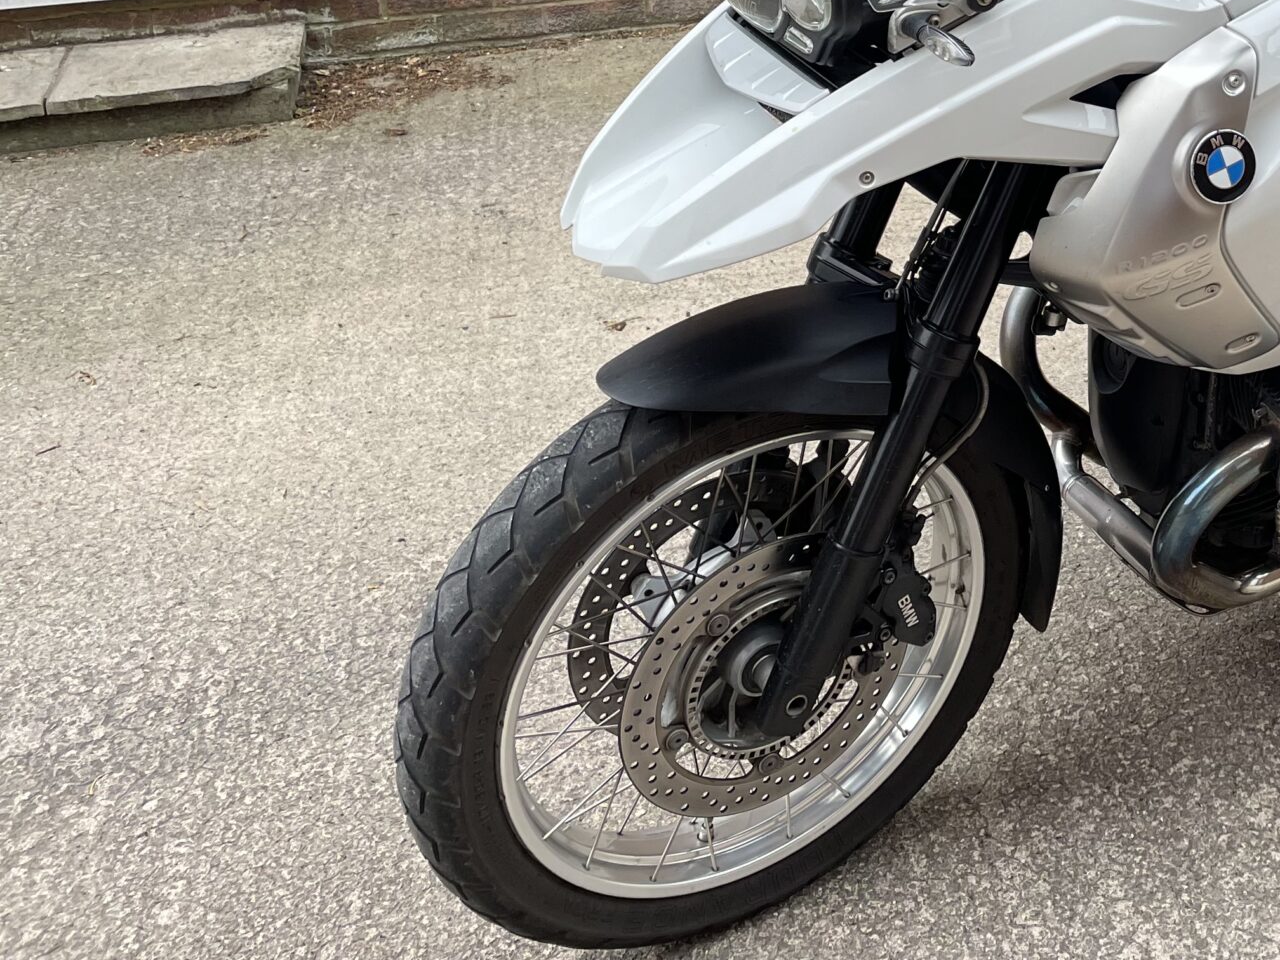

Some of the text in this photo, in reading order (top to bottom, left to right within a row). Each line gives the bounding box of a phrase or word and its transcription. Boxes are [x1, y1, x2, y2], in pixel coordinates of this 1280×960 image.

[1196, 135, 1245, 166] BMW
[1140, 234, 1208, 269] 1200
[1122, 252, 1214, 301] GS
[897, 594, 919, 628] BMW
